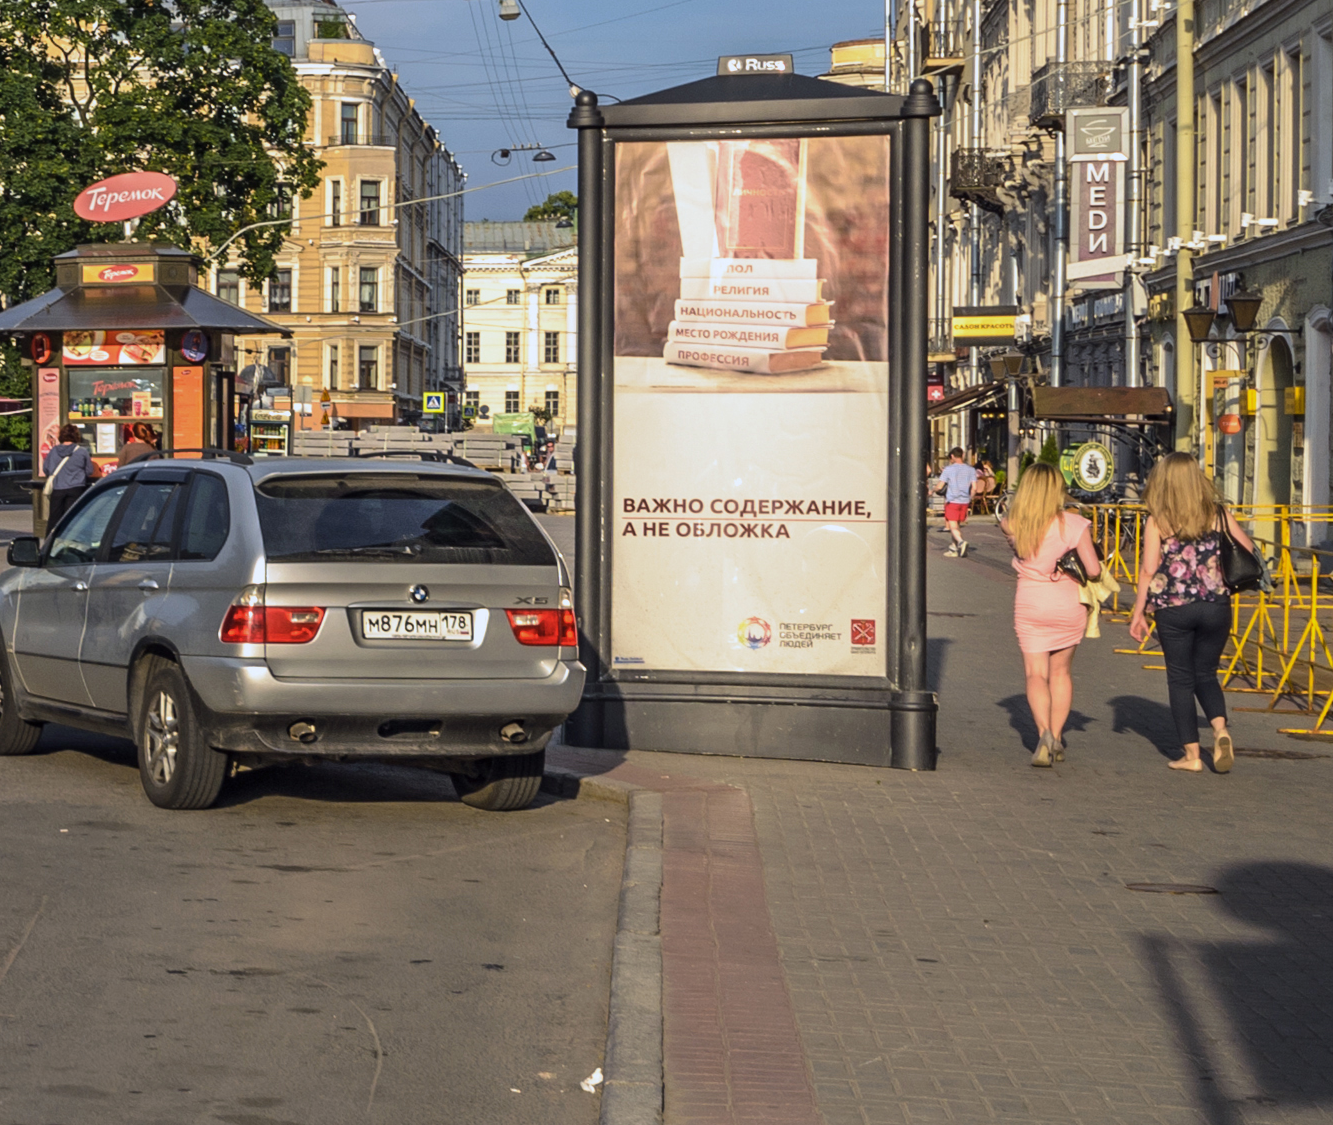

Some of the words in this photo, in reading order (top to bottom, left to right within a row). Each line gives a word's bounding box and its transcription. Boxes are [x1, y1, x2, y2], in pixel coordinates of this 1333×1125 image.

[745, 58, 786, 71] Russ
[86, 186, 165, 212] Теремок
[726, 264, 753, 273] ПОЛ
[713, 285, 769, 296] РЕЛИГИЯ
[680, 306, 797, 320] НАЦИОНАЛЬНОСТЬ
[675, 328, 711, 339] МЕСТО
[713, 329, 779, 342] РОЖДЕНИЯ
[677, 349, 750, 367] ПРОФЕССИЯ
[622, 498, 704, 514] ВАЖНО
[709, 498, 872, 519] СОДЕРЖАНИЕ,
[622, 522, 637, 537] А
[643, 522, 670, 538] НЕ
[675, 522, 791, 539] ОБЛОЖКА
[513, 596, 549, 605] X5
[368, 614, 438, 634] М876МН
[441, 615, 466, 629] 178
[779, 622, 834, 631] ПЕТЕРБУРГ
[779, 631, 842, 641] ОБЪЕДИНЯЕТ
[779, 640, 814, 649] ЛЮДЕЙ
